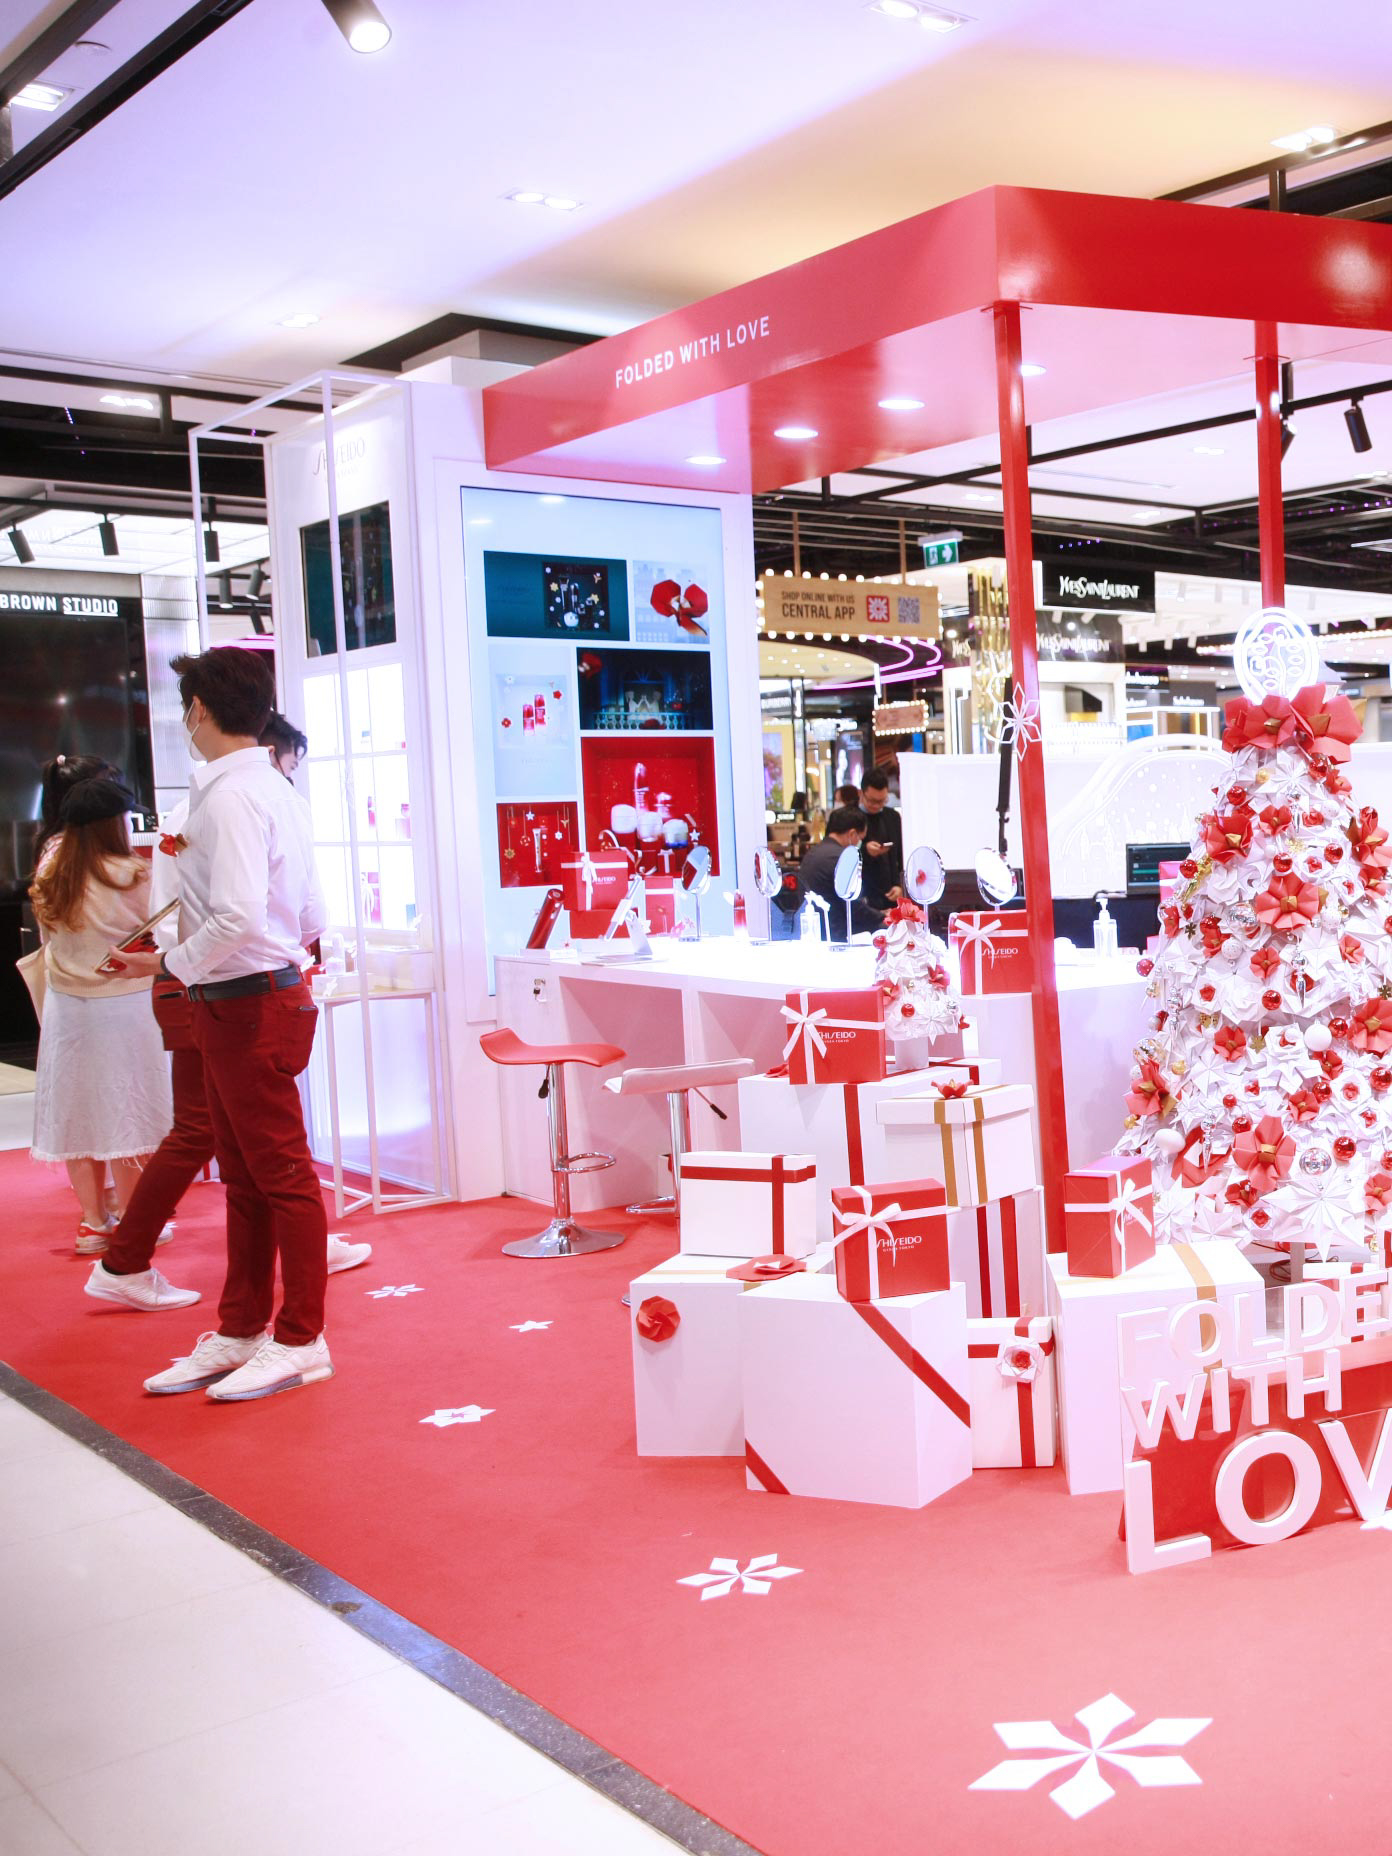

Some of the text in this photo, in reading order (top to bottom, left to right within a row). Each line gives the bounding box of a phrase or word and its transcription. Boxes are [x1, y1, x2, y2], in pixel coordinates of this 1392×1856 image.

[615, 315, 770, 389] FOLDED WITH LOVE
[0, 593, 119, 616] BROWN STUDIO
[782, 590, 855, 604] SHOP ONLINE WITH US
[782, 602, 855, 620] CENTRAL APP
[1120, 1348, 1342, 1449] WITH
